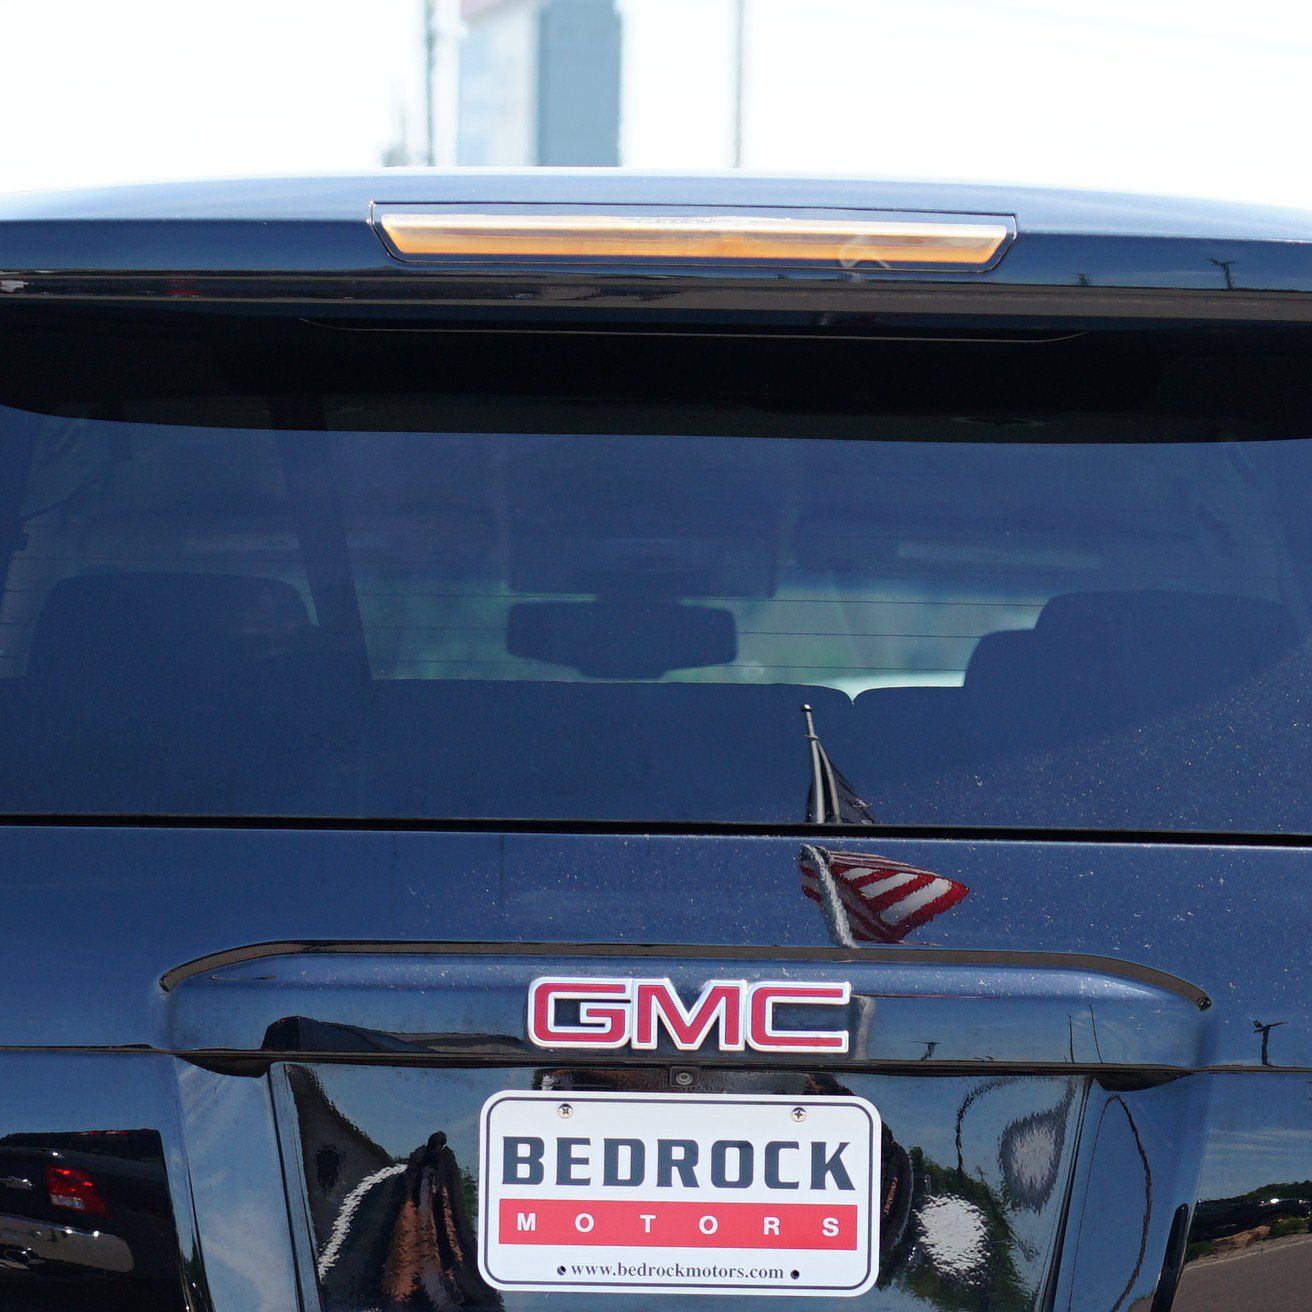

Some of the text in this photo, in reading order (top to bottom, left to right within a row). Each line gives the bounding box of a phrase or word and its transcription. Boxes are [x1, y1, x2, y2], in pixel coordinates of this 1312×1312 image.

[527, 976, 852, 1054] GMC
[501, 1135, 856, 1191] BEDROCK
[516, 1211, 840, 1237] MOTORS
[570, 1261, 785, 1280] www.bedrockmotors.com
